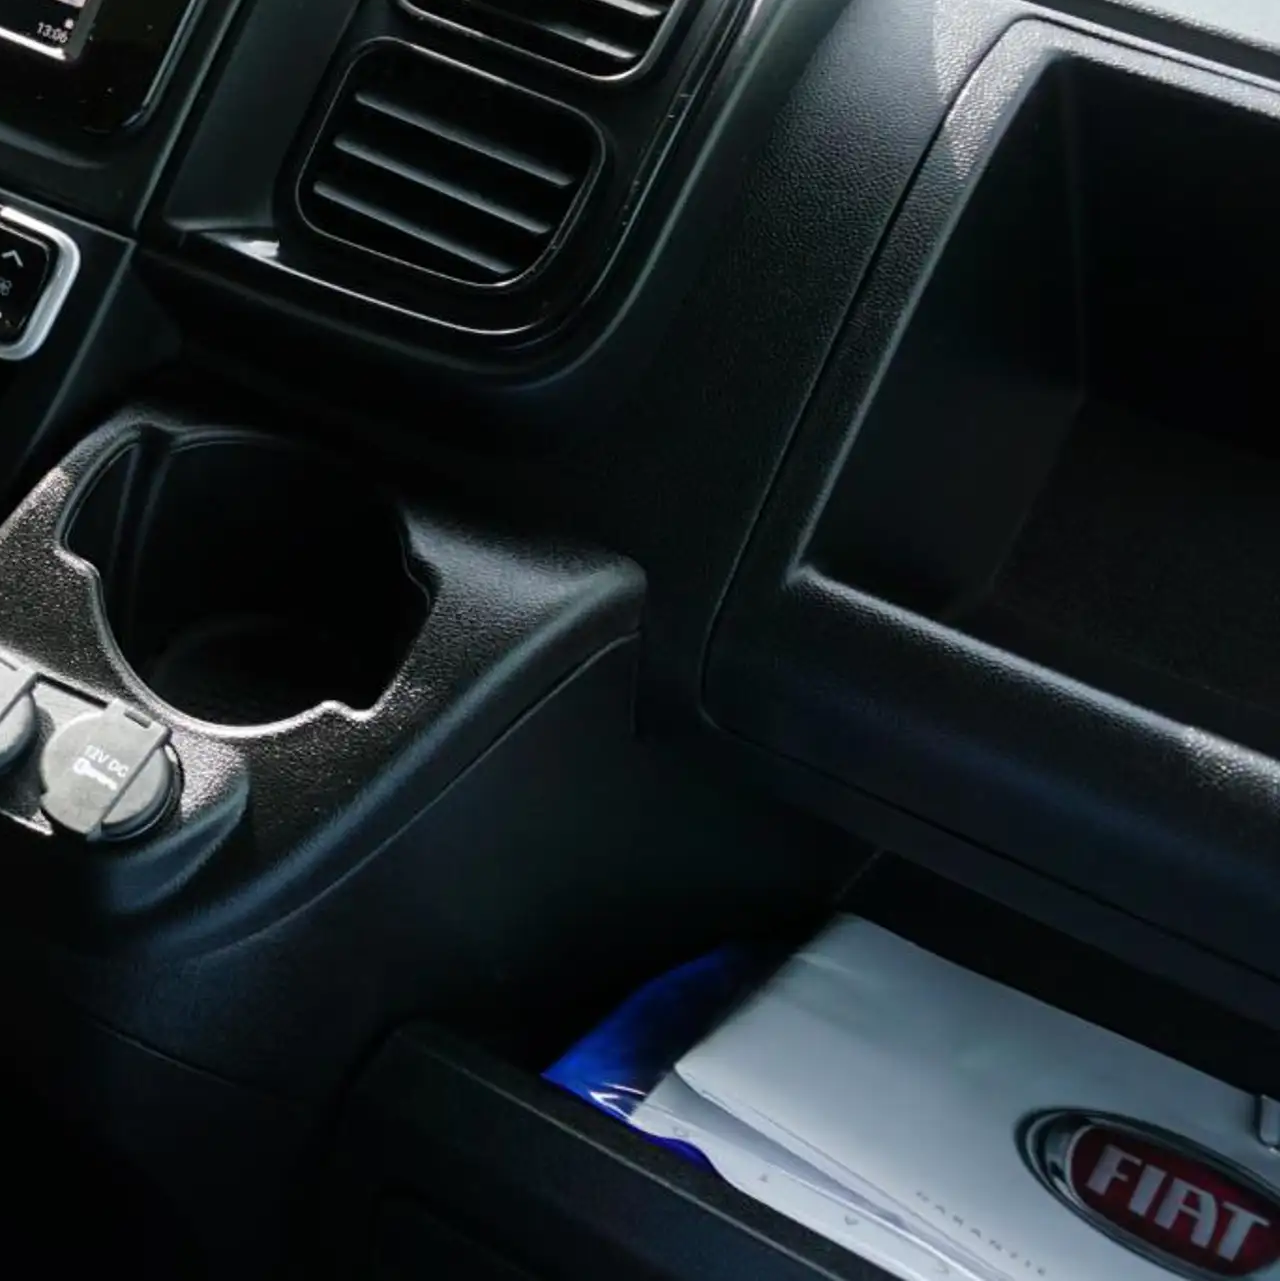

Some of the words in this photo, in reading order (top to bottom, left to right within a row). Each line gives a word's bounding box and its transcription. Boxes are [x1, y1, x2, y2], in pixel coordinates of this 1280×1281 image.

[37, 22, 68, 43] 13:06
[85, 745, 110, 765] 12V
[107, 758, 129, 778] DC
[1086, 1144, 1271, 1262] FIAT
